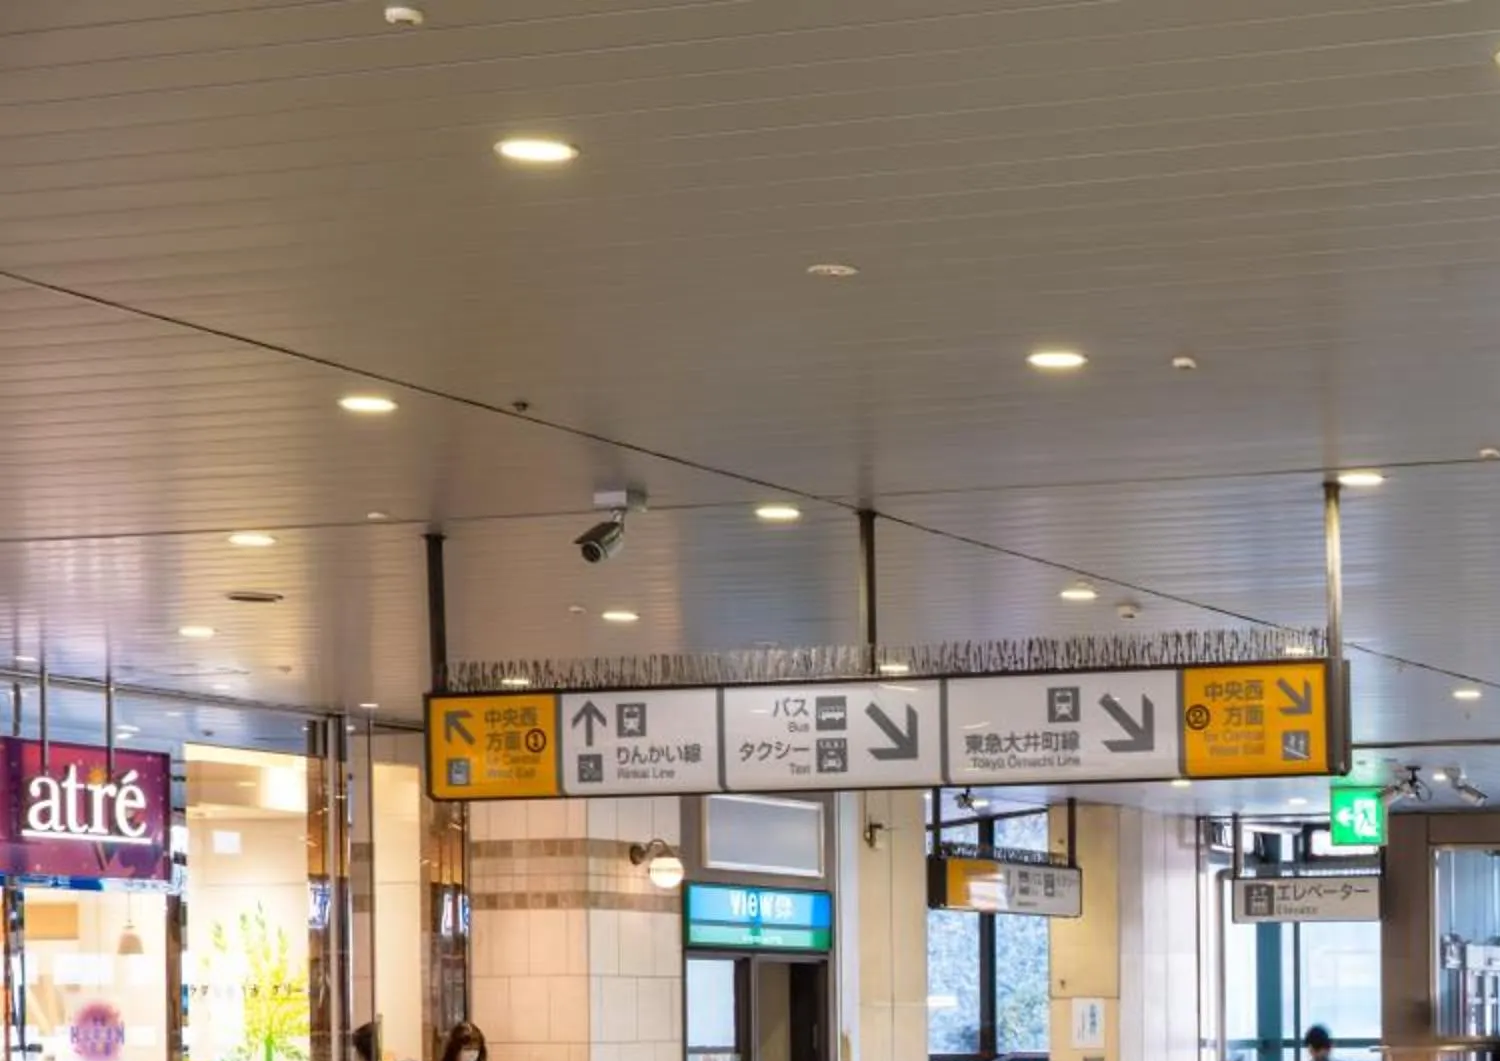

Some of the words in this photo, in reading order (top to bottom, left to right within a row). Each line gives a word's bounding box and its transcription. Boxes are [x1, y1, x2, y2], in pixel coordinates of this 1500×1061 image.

[1204, 679, 1264, 702] 中央西
[773, 697, 809, 717] バス
[739, 741, 810, 762] タクシー
[965, 730, 1080, 754] 東急大井町線
[617, 744, 701, 765] りんかい線
[28, 763, 147, 837] atré
[1276, 883, 1370, 900] エレベーター
